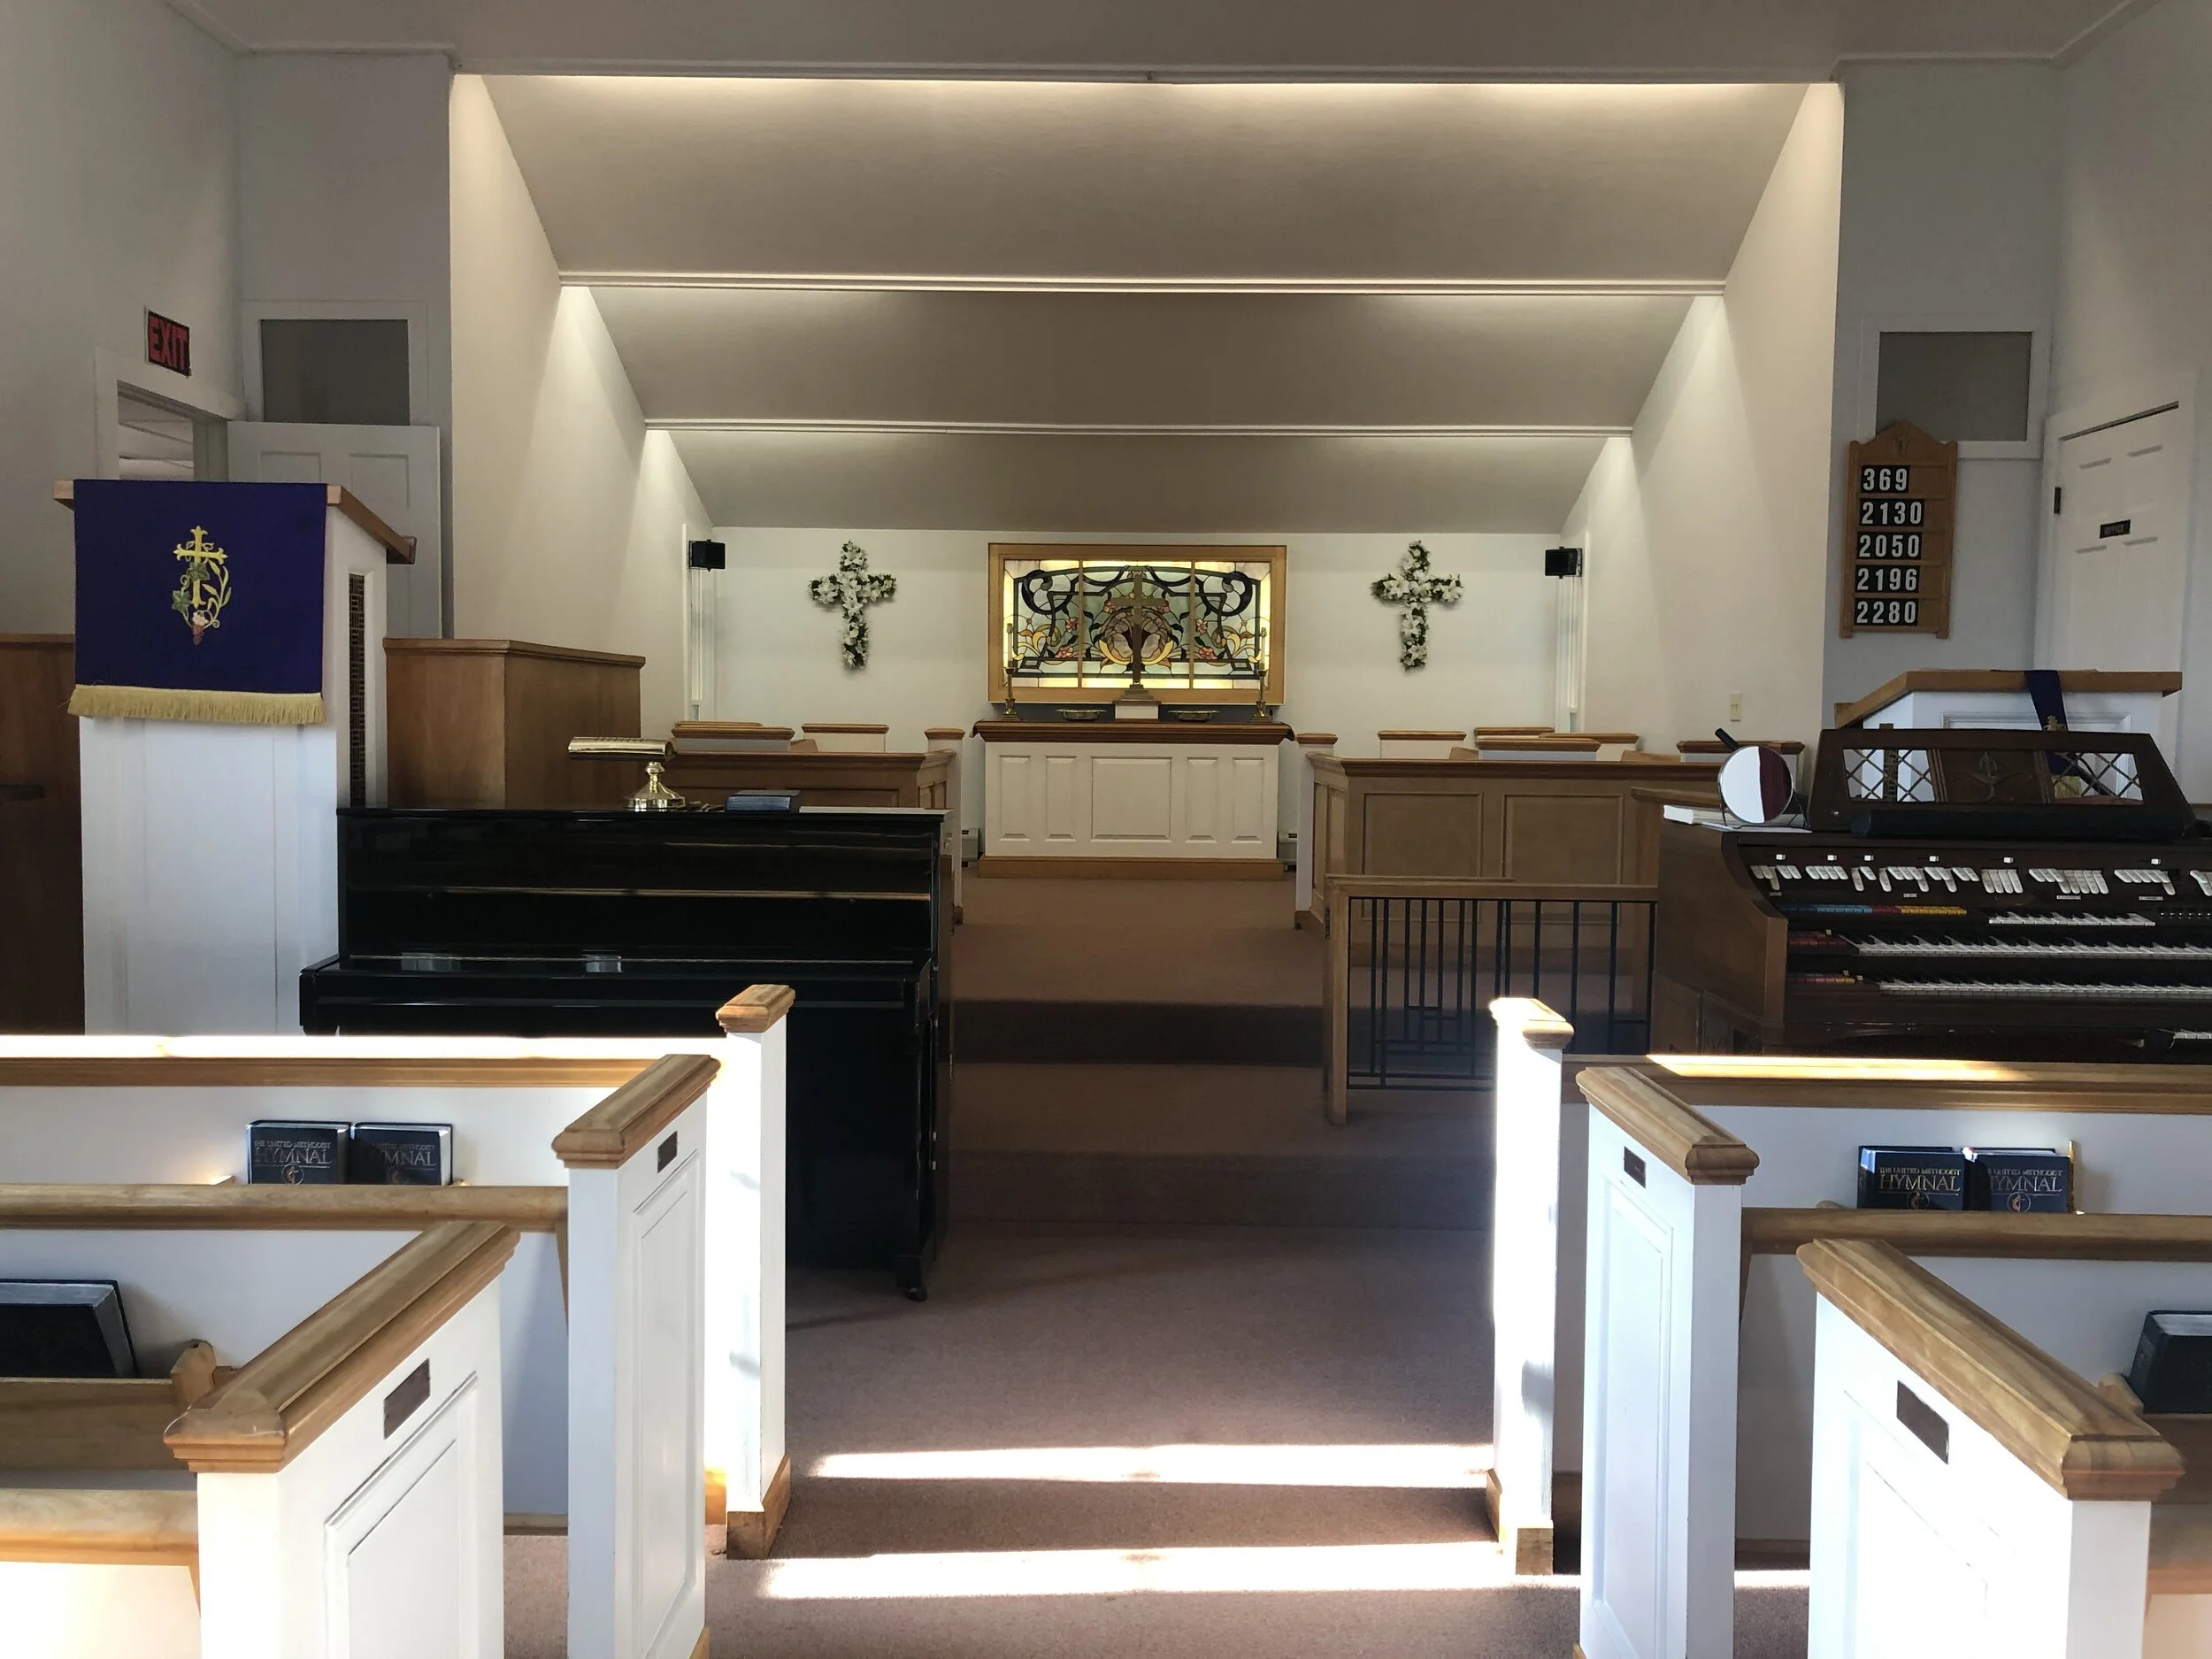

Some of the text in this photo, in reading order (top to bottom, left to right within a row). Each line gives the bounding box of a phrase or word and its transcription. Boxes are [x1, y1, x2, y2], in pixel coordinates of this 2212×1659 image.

[150, 316, 187, 370] EXIT
[1863, 467, 1908, 491] 369
[1861, 501, 1922, 525] 2130
[1858, 534, 1920, 557] 2050
[1856, 567, 1917, 591] 2196
[1856, 601, 1916, 624] 2280
[254, 1147, 333, 1164] HYMNAL
[1879, 1174, 1961, 1191] HYMNAL
